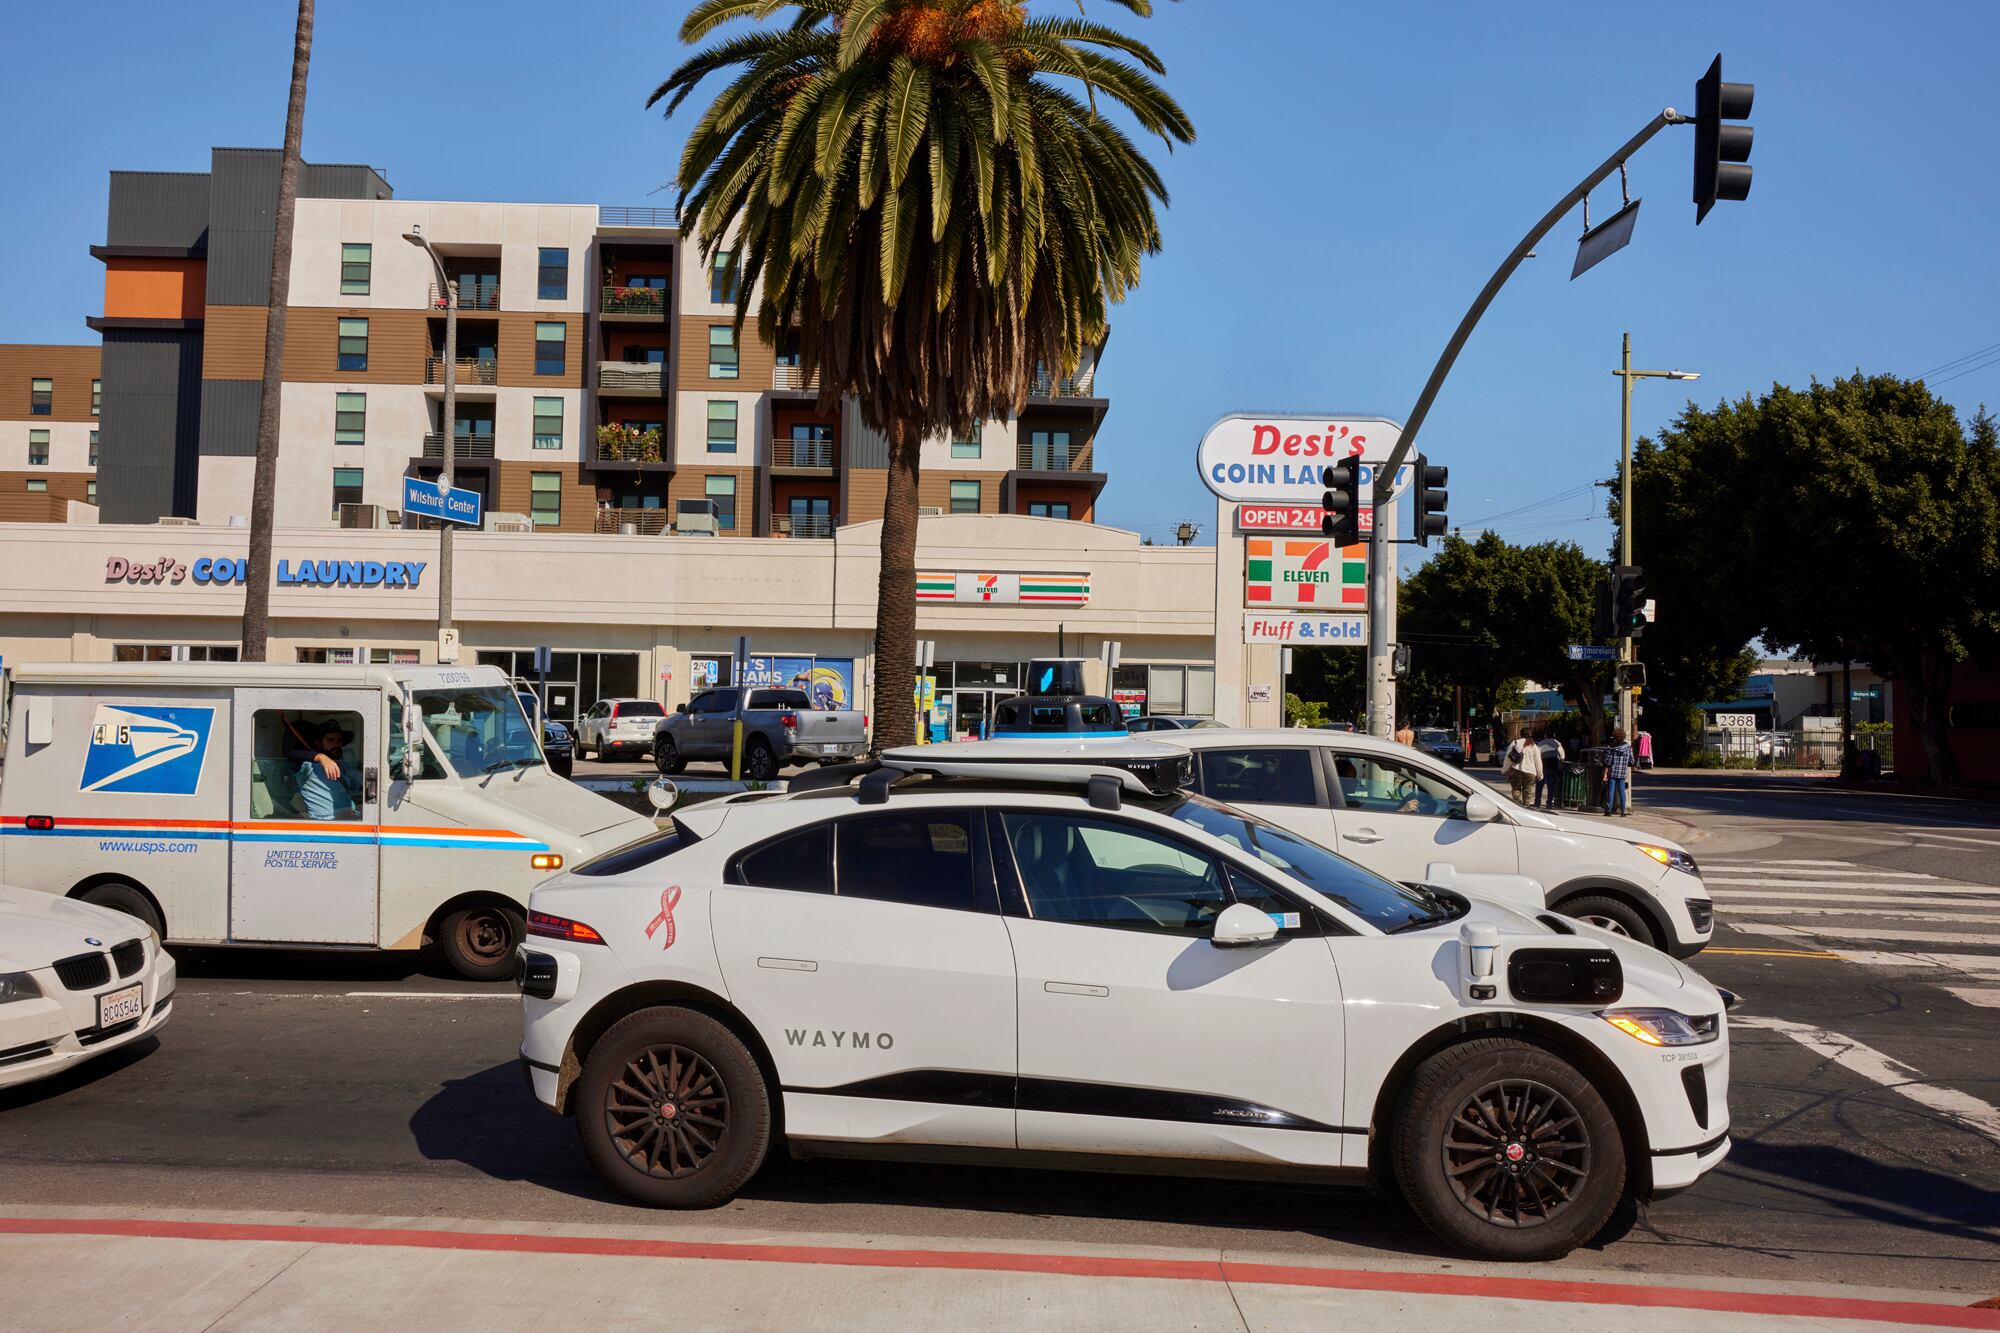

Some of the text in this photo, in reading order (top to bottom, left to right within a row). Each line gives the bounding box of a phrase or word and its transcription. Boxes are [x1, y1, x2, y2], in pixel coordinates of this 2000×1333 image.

[1251, 425, 1366, 457] Desi's
[1212, 463, 1275, 484] COIN
[410, 489, 476, 514] Wilshire Center
[1245, 510, 1288, 524] OPEN
[1291, 510, 1316, 526] 24
[106, 556, 427, 585] Desi's COI LAUNDRY
[1252, 621, 1361, 640] Fluff & Fold
[1720, 715, 1754, 727] 2368
[99, 841, 198, 855] www.usps.com
[266, 850, 336, 860] UNITED STATES
[264, 859, 338, 869] POSTAL SERVICE
[784, 1028, 894, 1050] WAYMO
[1661, 1053, 1676, 1063] TCP
